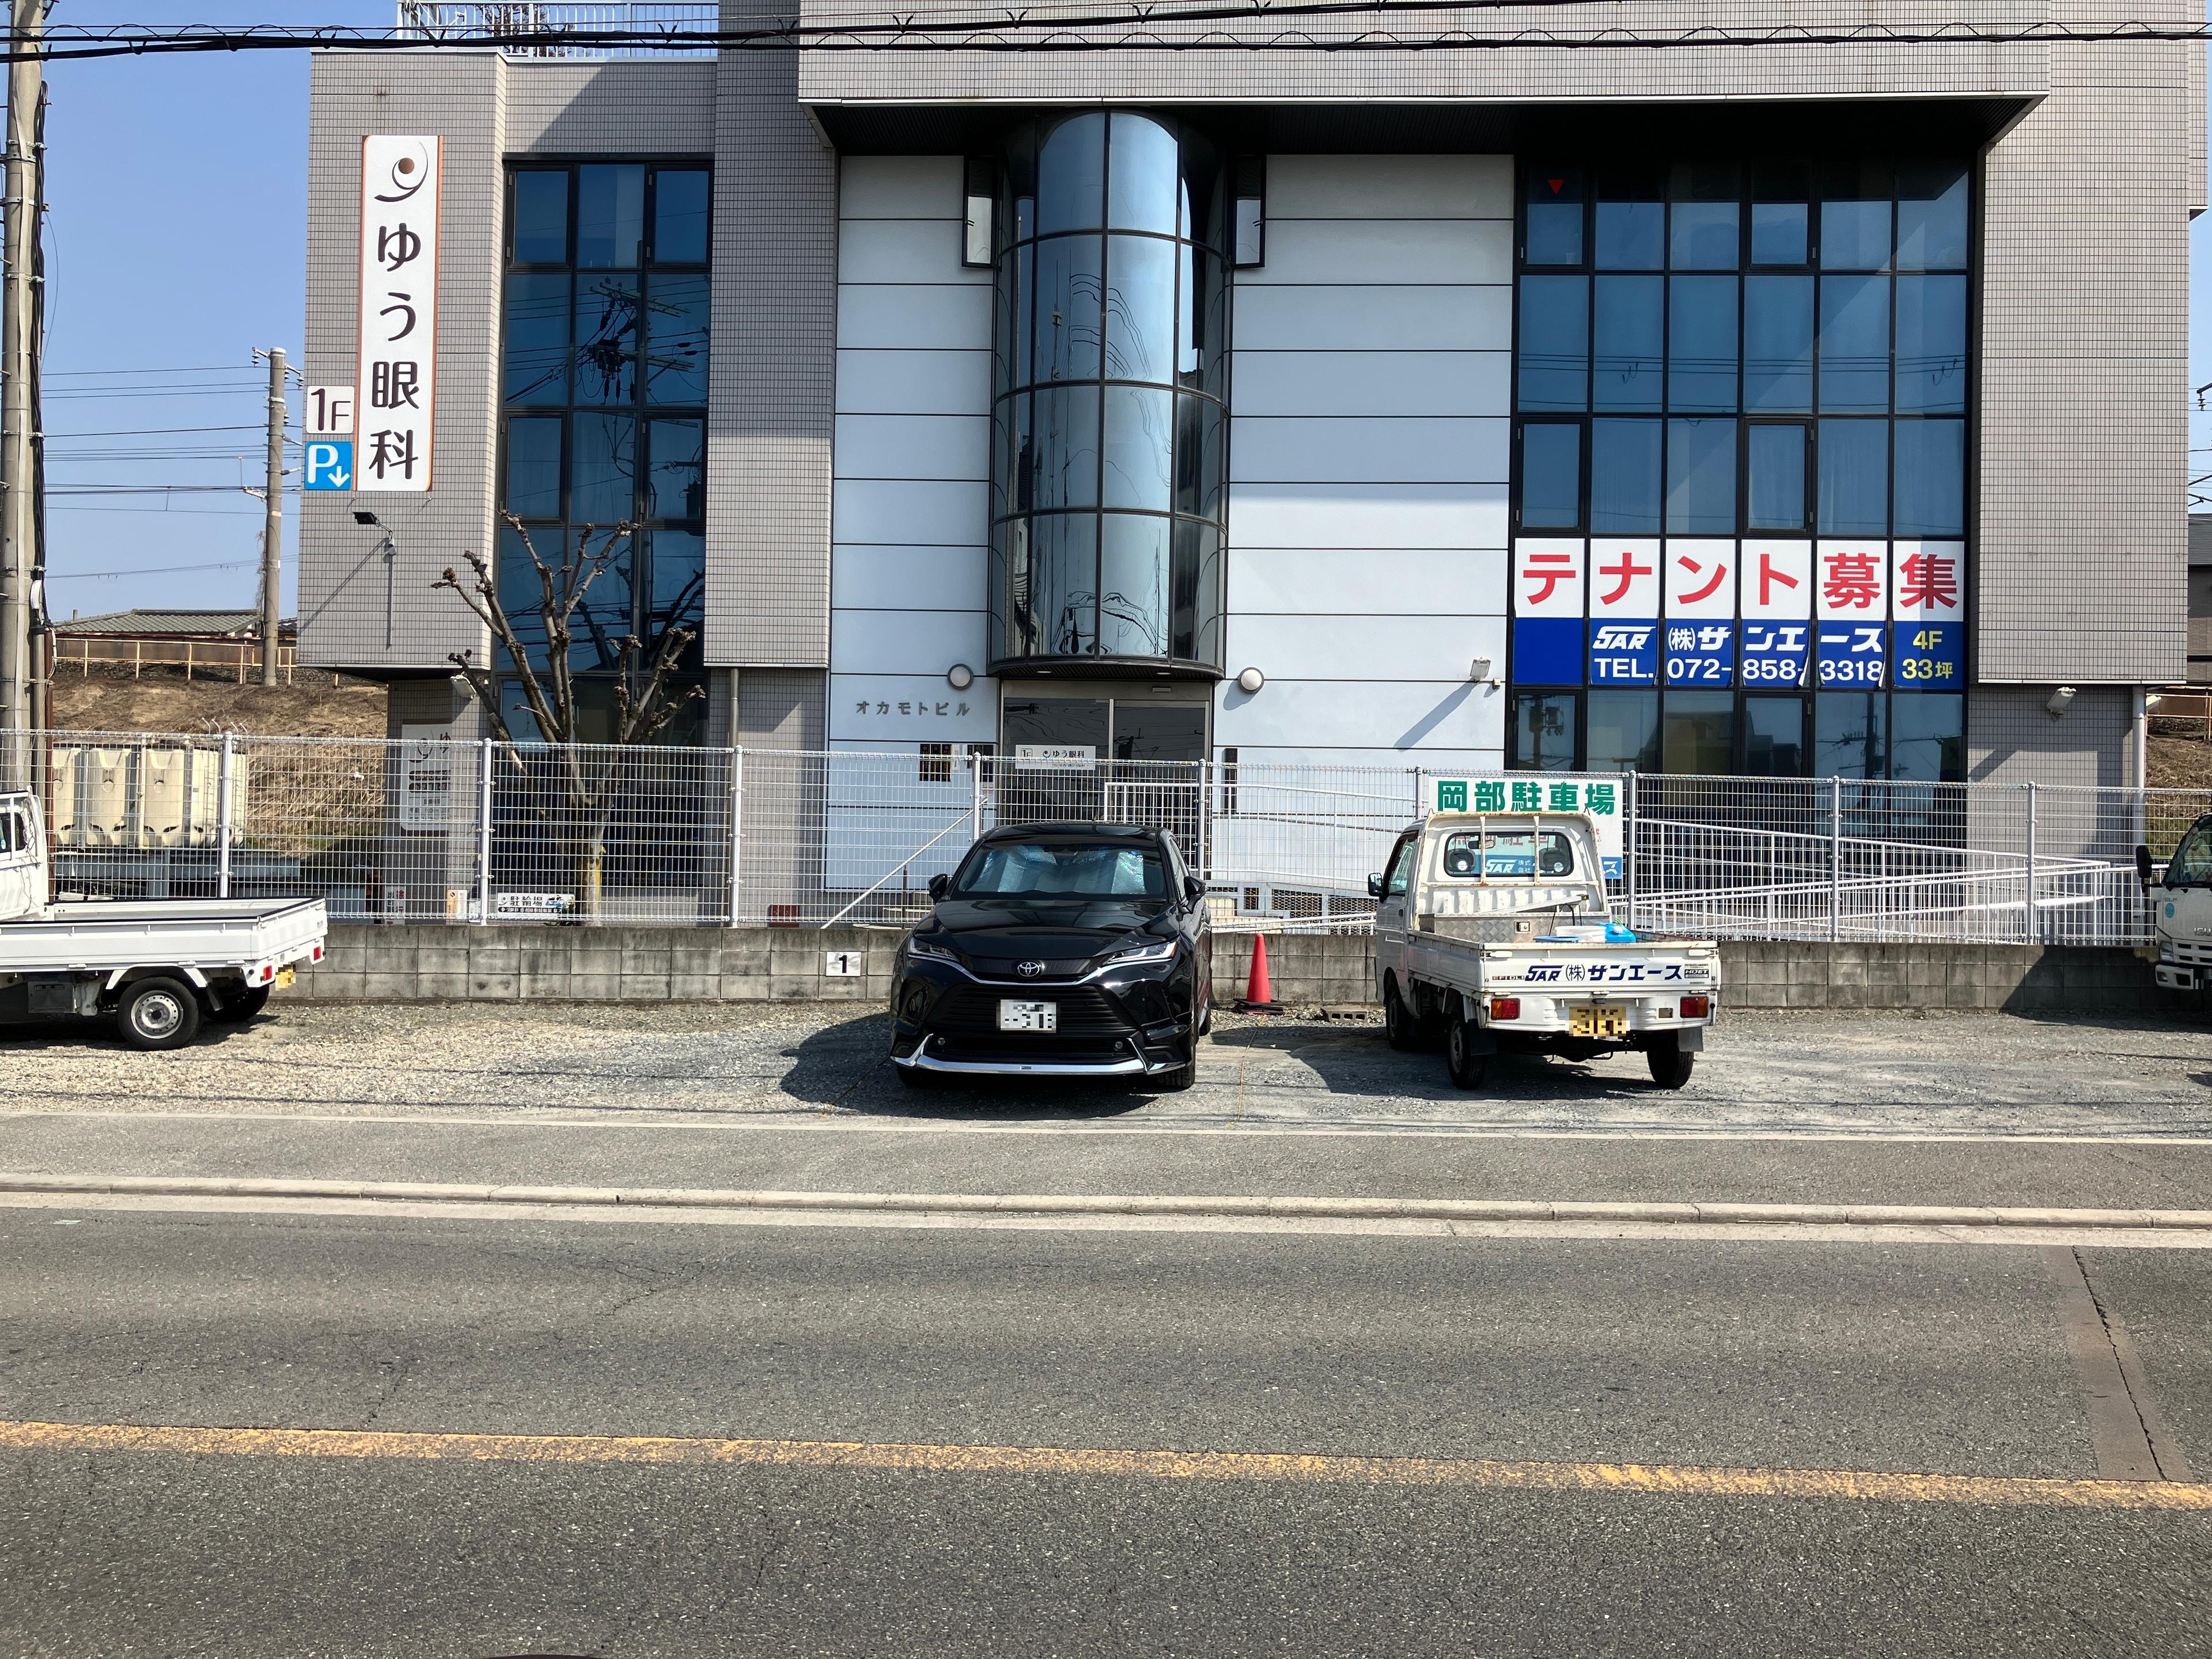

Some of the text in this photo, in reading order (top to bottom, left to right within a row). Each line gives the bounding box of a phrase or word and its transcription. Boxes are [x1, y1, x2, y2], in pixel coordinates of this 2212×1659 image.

[369, 222, 421, 480] ゆう眼科
[311, 388, 351, 431] 1F
[308, 445, 338, 484] P
[1524, 552, 1957, 609] テナント募集
[1912, 631, 1943, 650] 4F
[1594, 658, 1654, 678] TEL.
[1902, 658, 1953, 679] 33坪
[856, 700, 970, 716] オカモトビル
[1052, 750, 1085, 758] ゆう眼科
[1438, 781, 1615, 815] 岡部駐車場
[839, 955, 847, 973] 1
